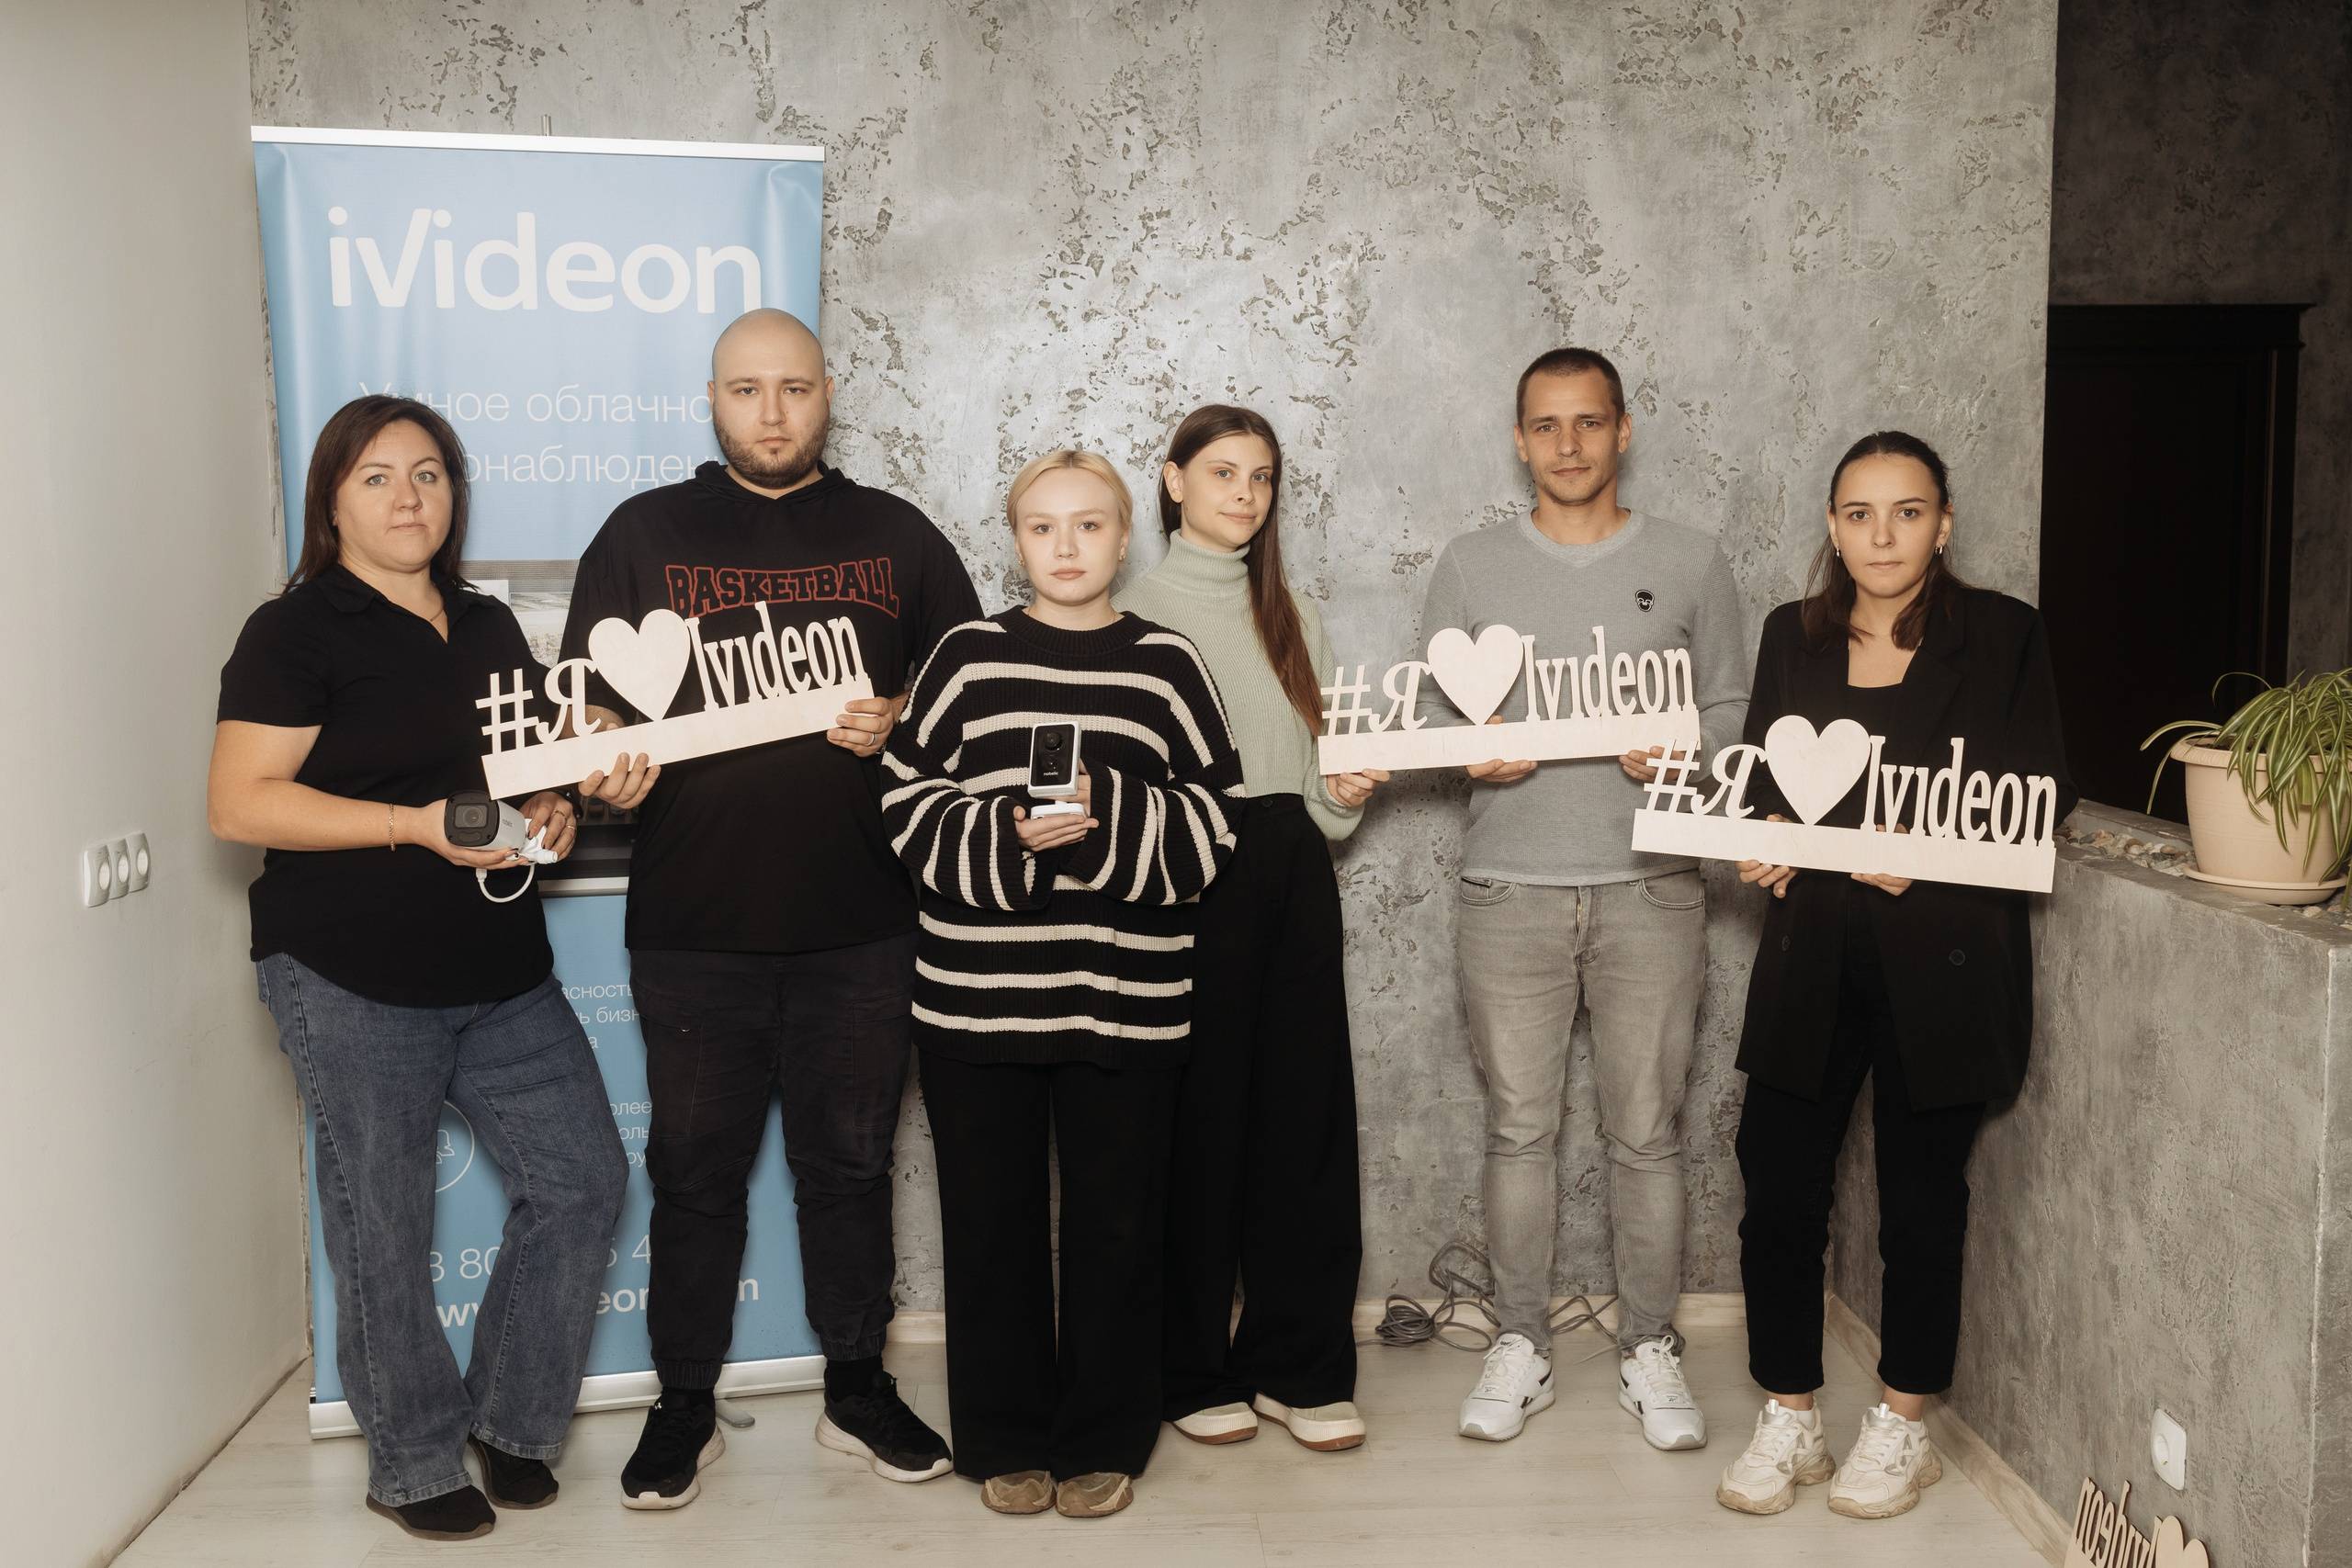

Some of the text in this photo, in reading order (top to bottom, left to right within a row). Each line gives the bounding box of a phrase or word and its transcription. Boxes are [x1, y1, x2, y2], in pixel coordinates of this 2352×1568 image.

[359, 381, 714, 423] ное облачно
[463, 445, 718, 490] онаблюден
[665, 557, 899, 619] BASKETBALL
[684, 601, 870, 712] Ivideon
[1521, 626, 1698, 722] Ivideon
[1860, 735, 2057, 848] Ivideon
[596, 1006, 640, 1024] бизн
[610, 1101, 652, 1115] олее
[459, 1246, 501, 1280] 80
